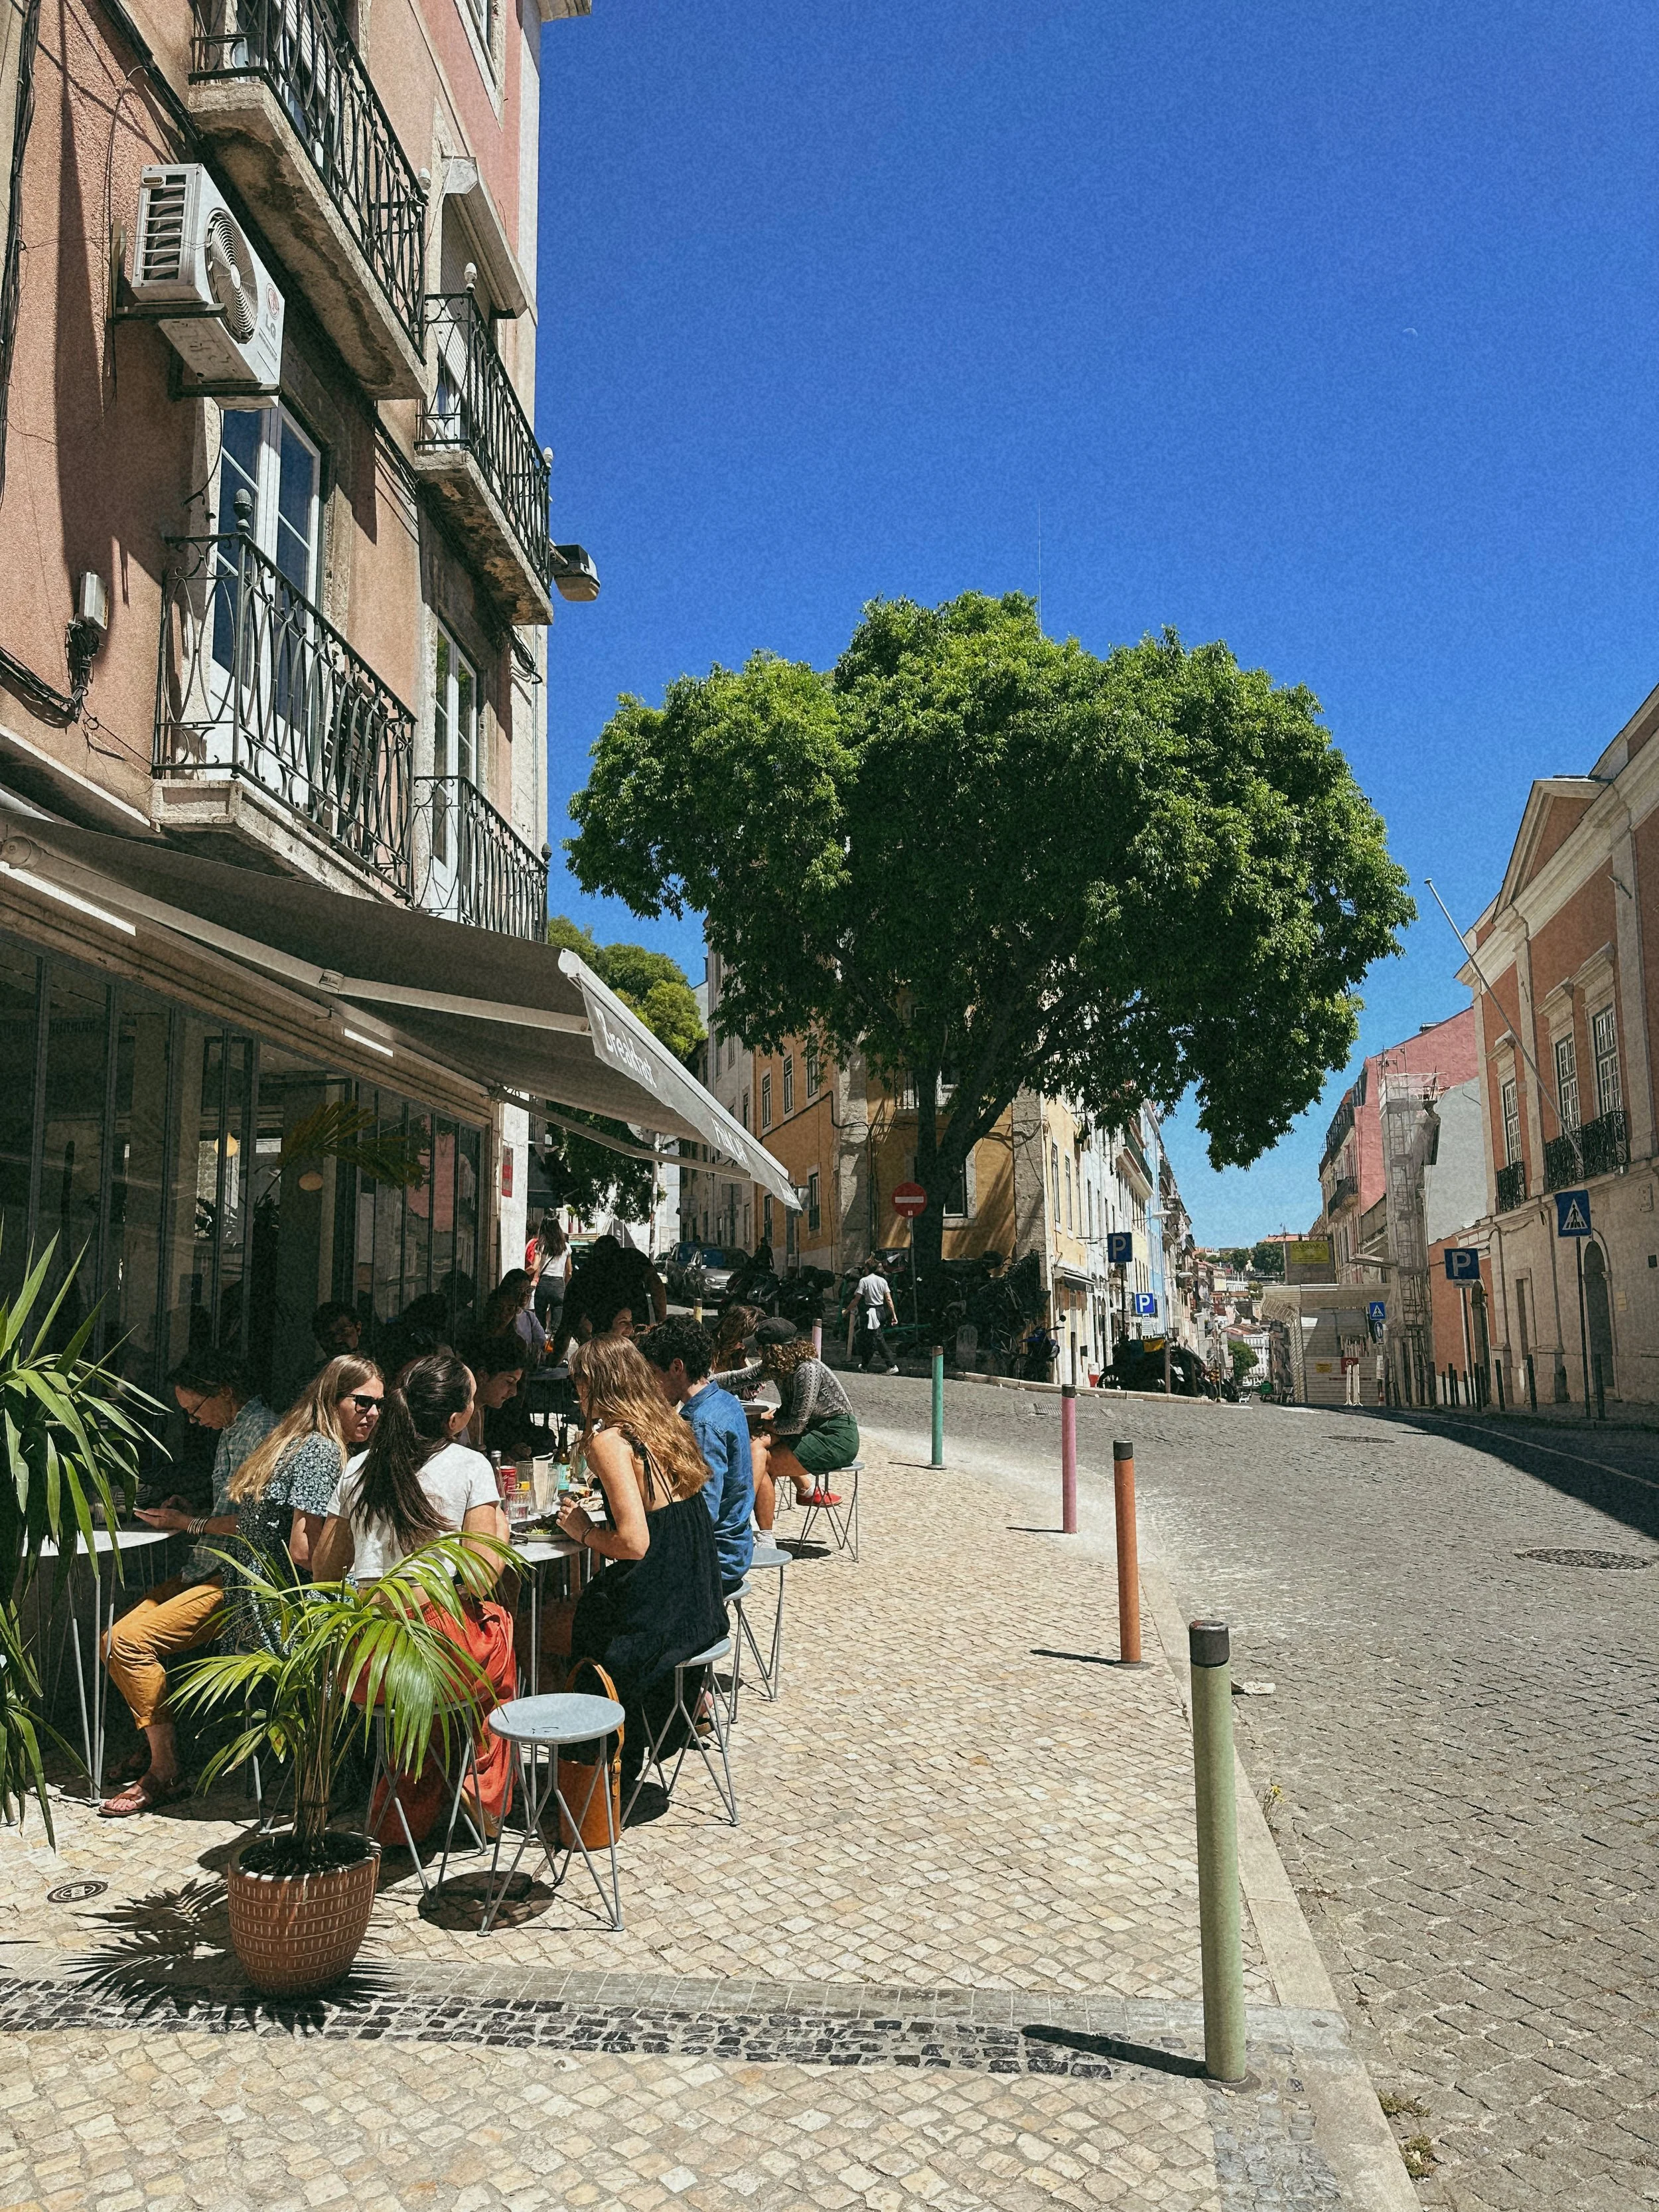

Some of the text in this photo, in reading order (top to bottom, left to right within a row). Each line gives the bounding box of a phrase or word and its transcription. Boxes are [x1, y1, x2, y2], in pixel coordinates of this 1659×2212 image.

[265, 313, 276, 341] LG
[1112, 1236, 1127, 1260] P
[1451, 1251, 1471, 1277] P
[1139, 1294, 1151, 1313] P
